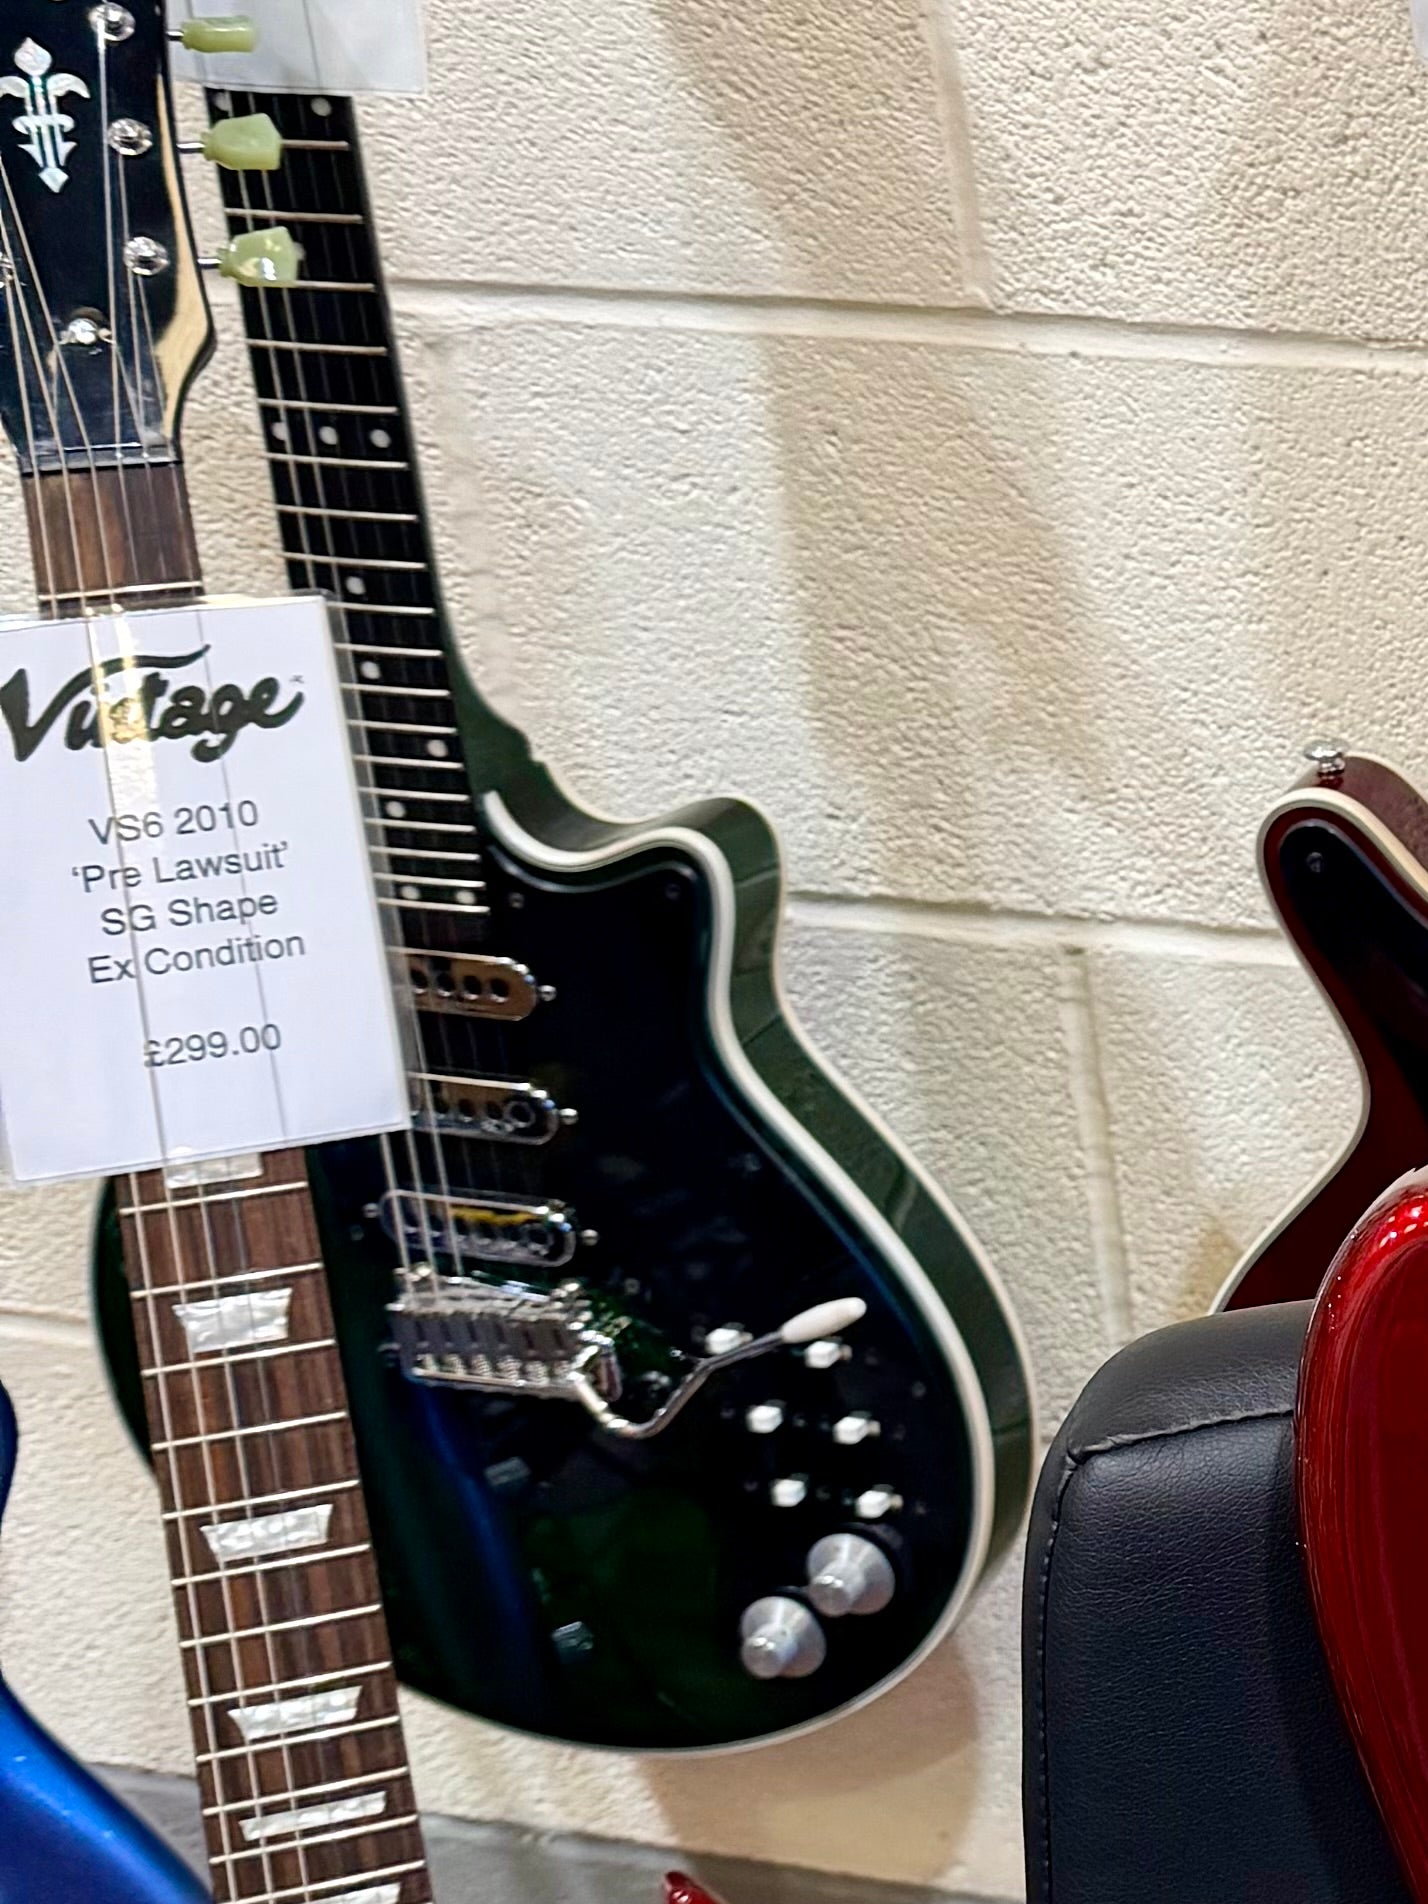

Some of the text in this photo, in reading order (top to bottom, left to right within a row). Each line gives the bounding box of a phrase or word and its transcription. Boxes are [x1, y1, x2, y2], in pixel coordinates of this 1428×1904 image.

[88, 800, 259, 845] VS6 2010
[101, 892, 279, 935] SG Shape
[87, 931, 306, 984] Ex Condition
[143, 1023, 282, 1068] £299.00
